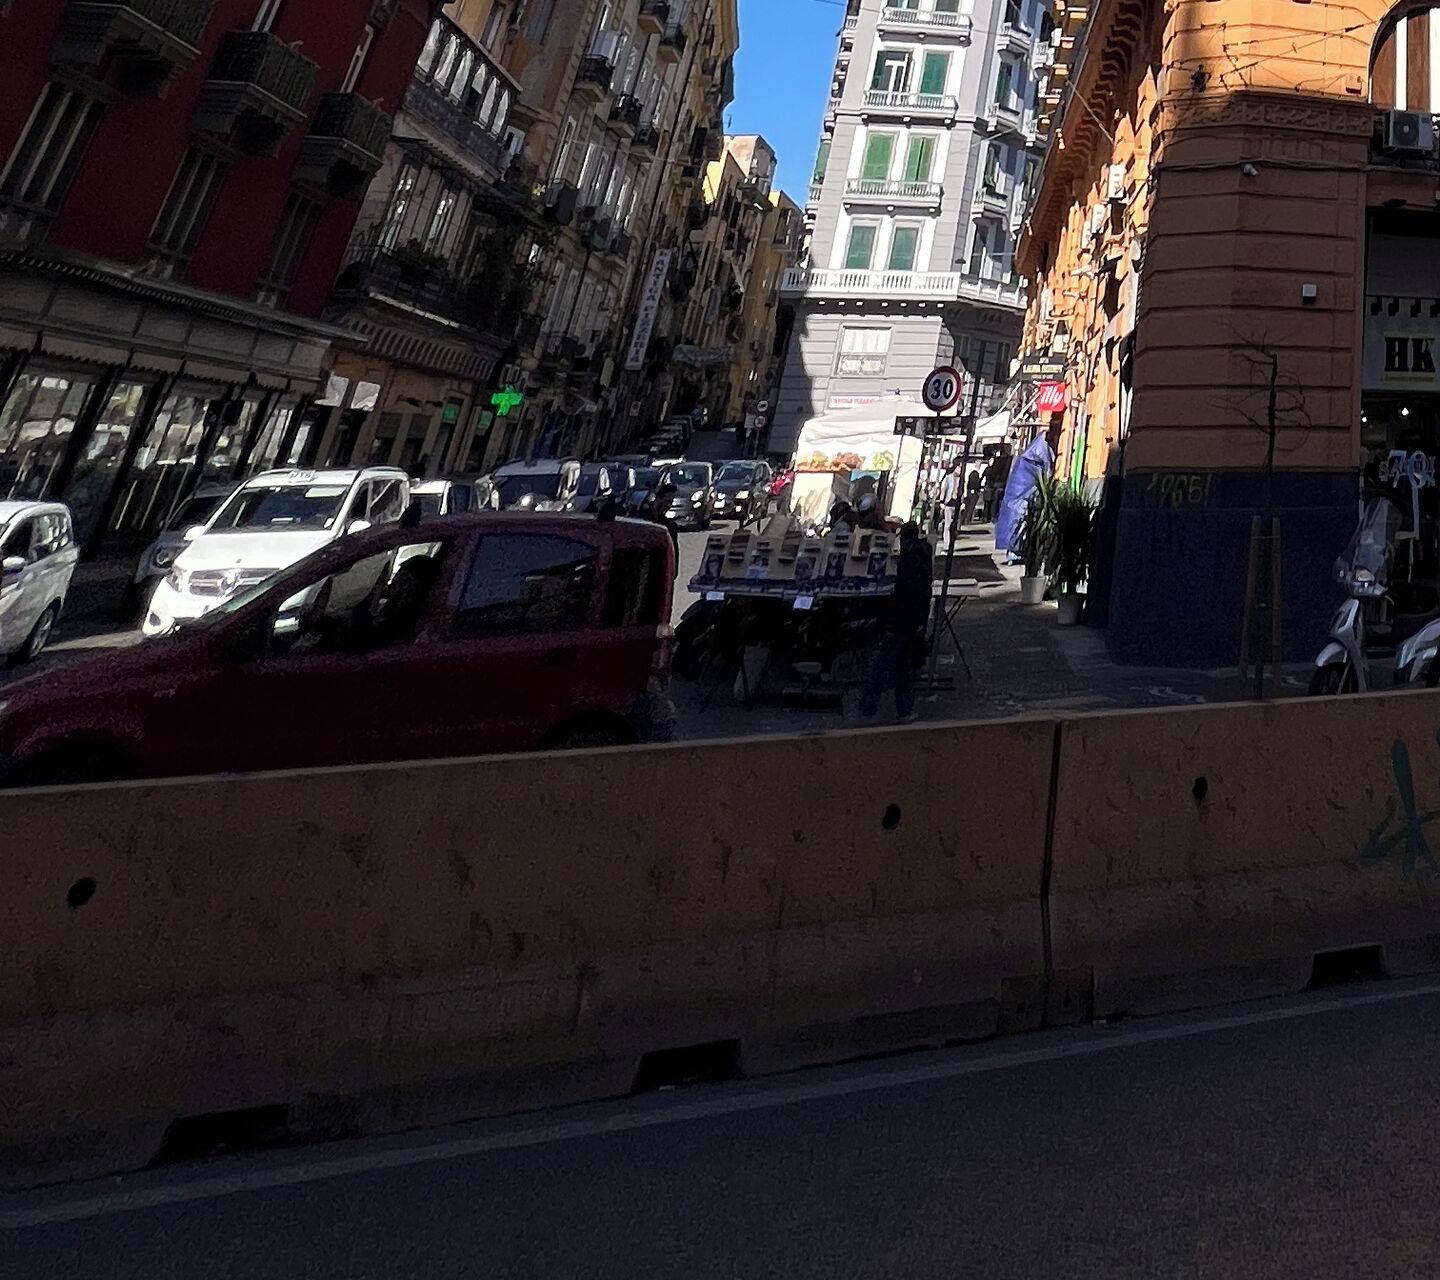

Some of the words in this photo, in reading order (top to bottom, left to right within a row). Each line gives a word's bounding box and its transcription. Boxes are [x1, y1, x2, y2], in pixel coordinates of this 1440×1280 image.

[1384, 337, 1436, 372] HK
[930, 378, 954, 401] 30
[1039, 384, 1063, 408] illy
